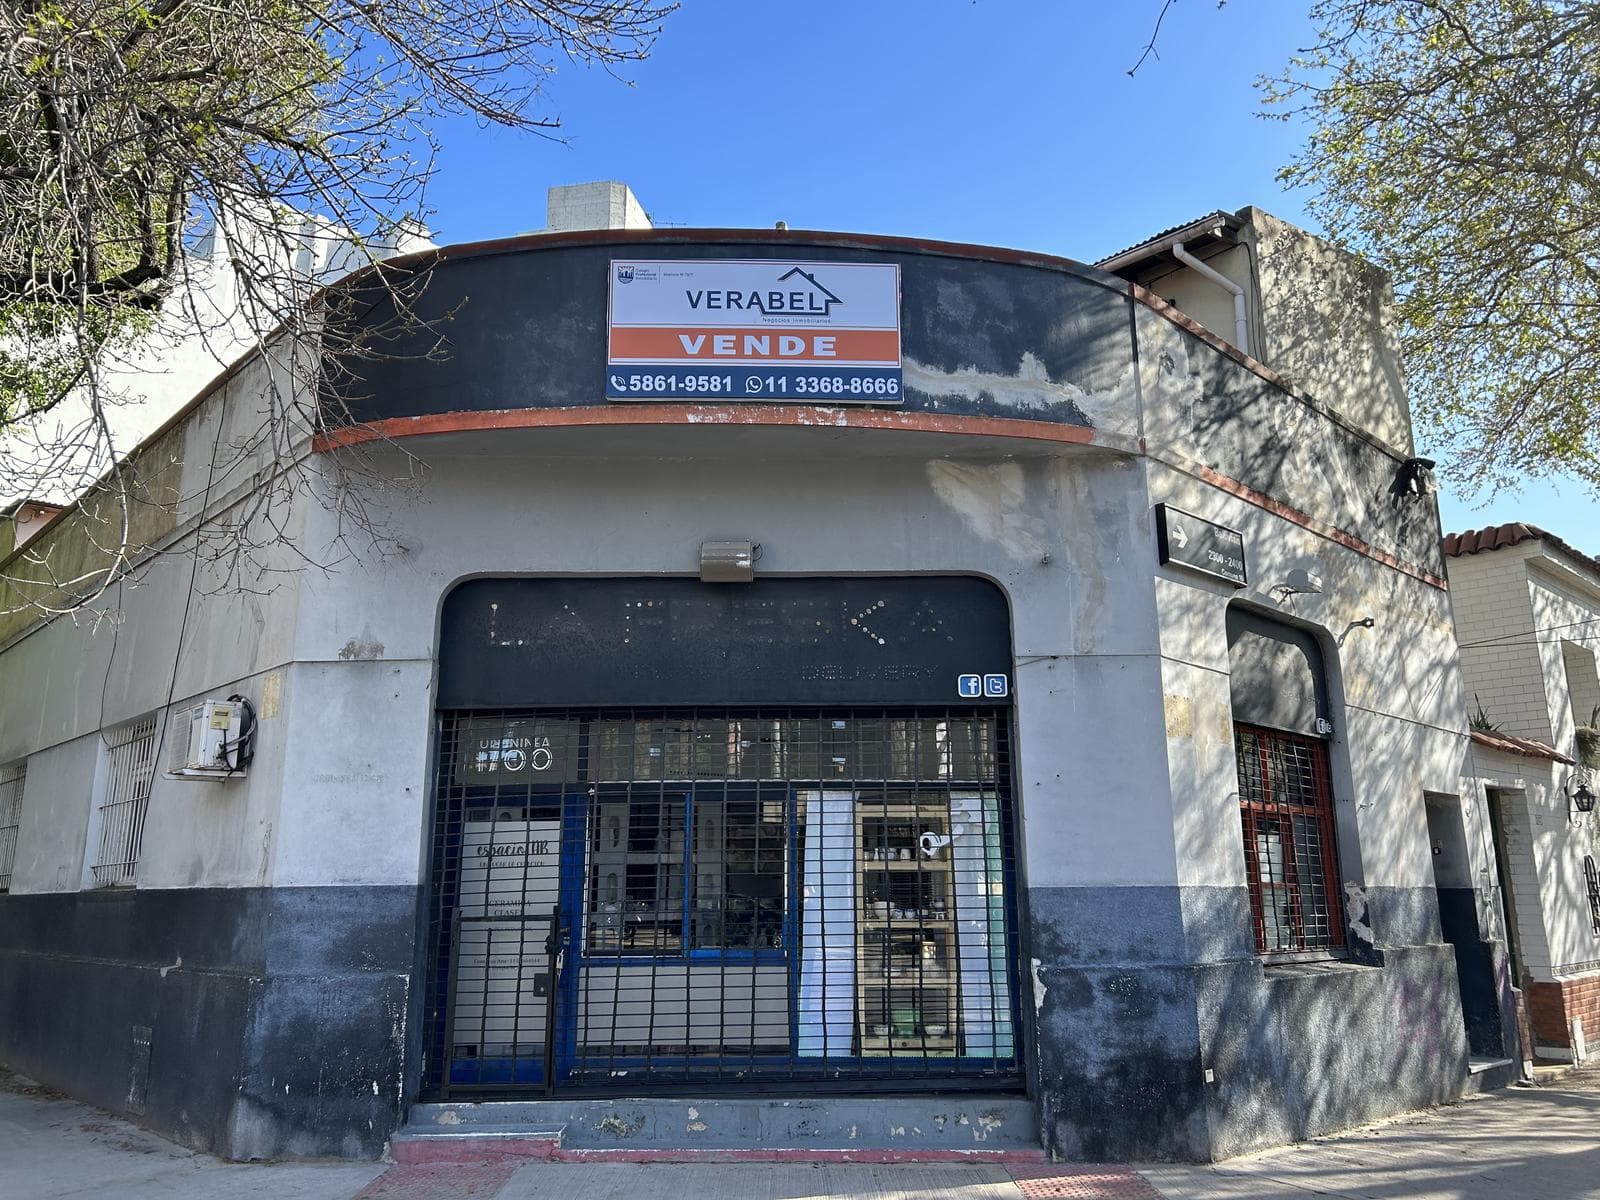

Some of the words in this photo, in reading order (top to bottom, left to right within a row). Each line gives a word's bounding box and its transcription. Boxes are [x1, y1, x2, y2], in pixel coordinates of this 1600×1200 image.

[686, 290, 823, 311] VERABEL
[679, 334, 837, 357] VENDE
[629, 375, 732, 392] 5861-9581
[765, 378, 787, 393] 11
[795, 377, 899, 394] 3368-8666
[494, 909, 525, 917] CLASE
